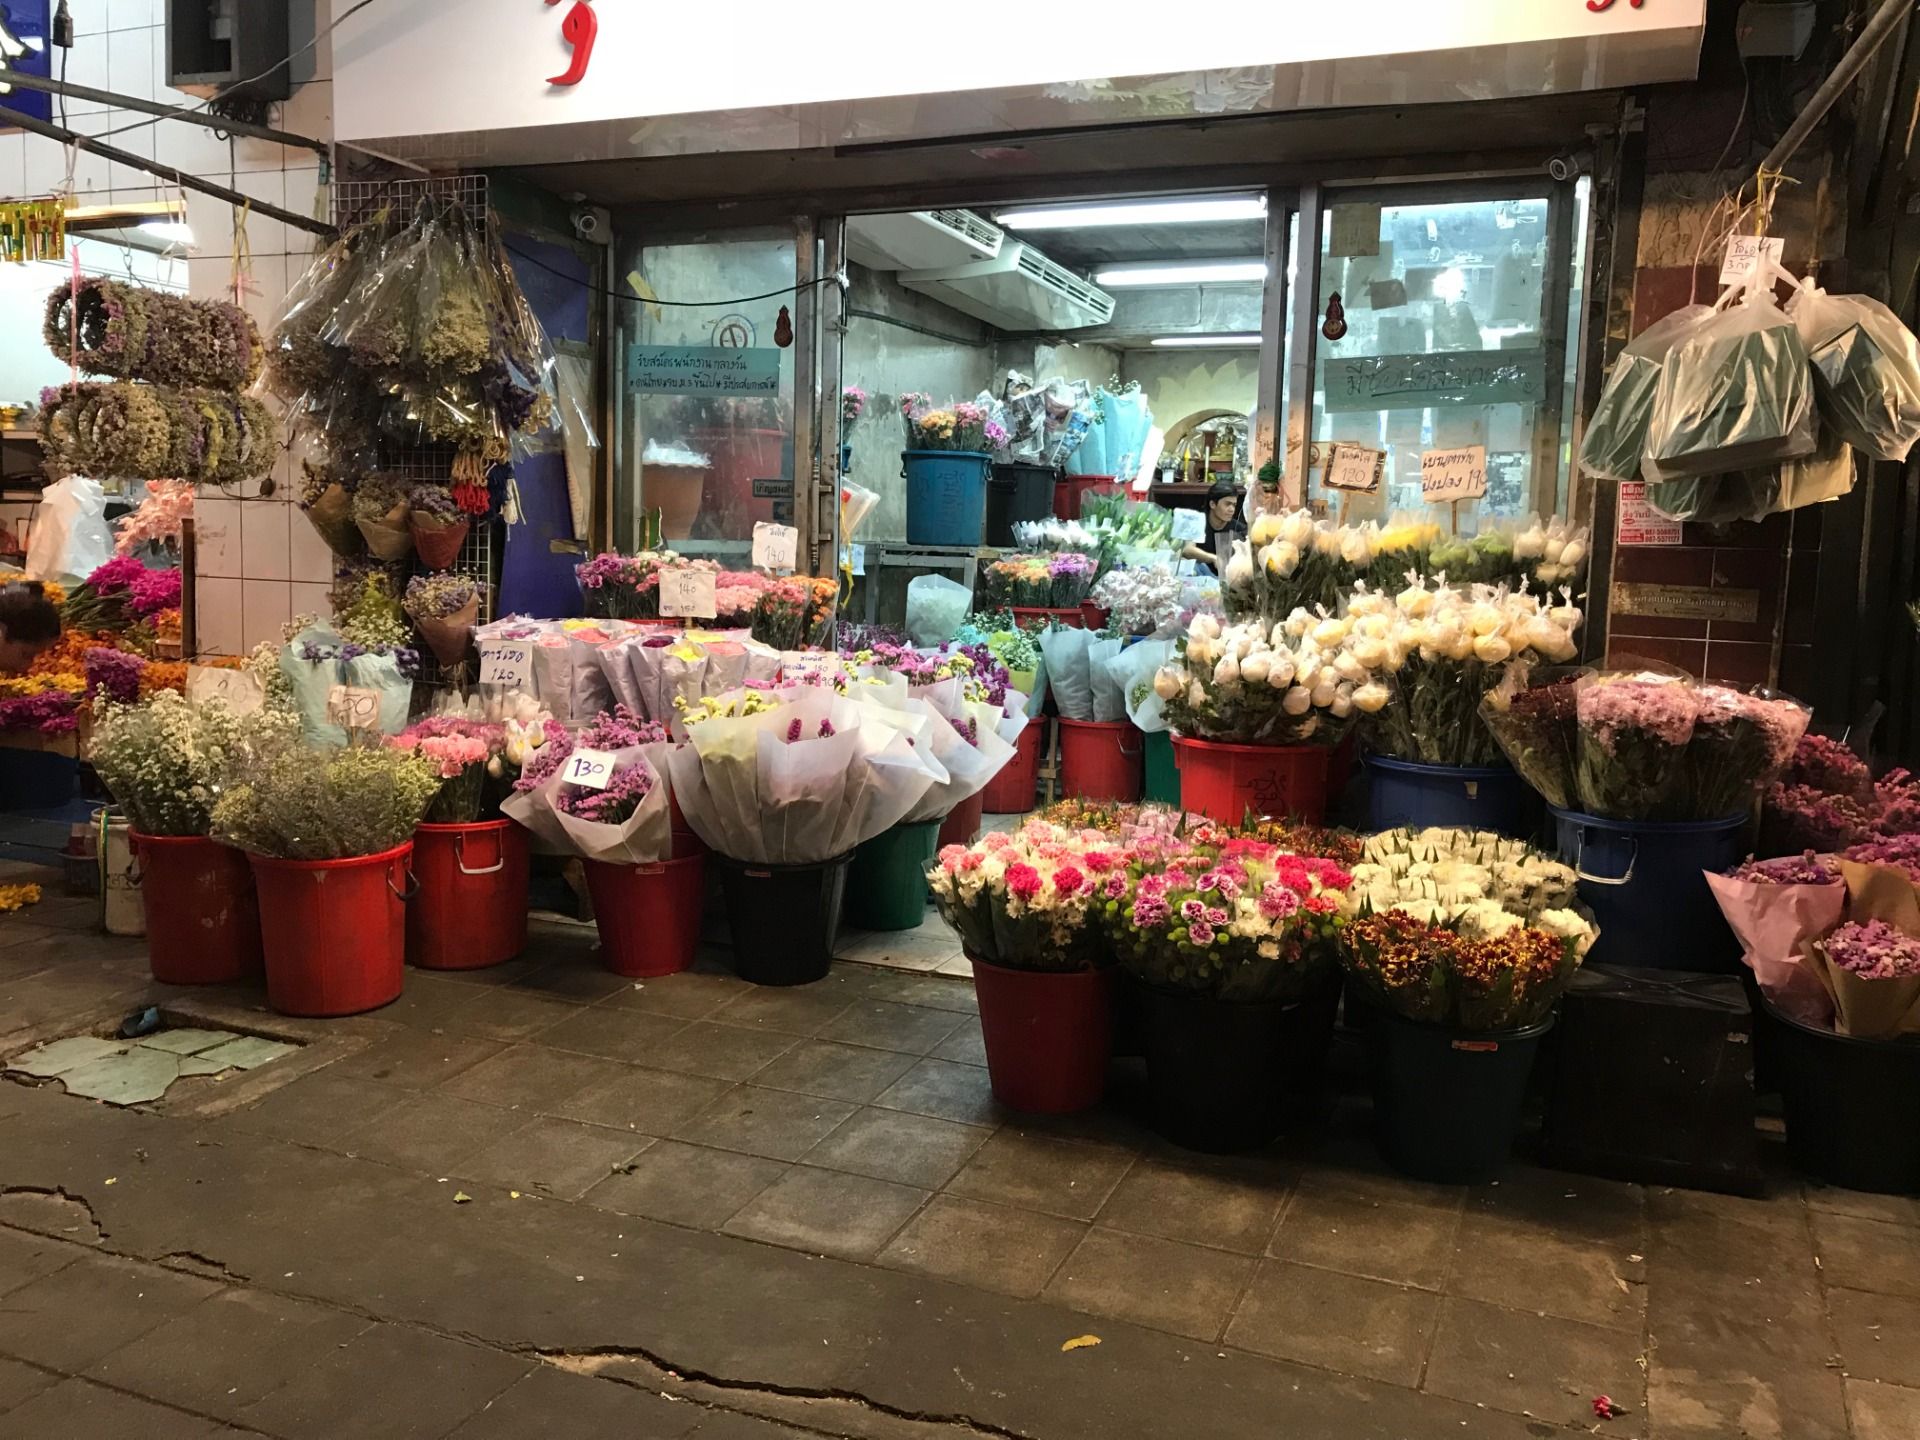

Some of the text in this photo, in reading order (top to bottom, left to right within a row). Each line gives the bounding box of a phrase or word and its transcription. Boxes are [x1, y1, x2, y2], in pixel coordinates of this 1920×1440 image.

[1342, 467, 1366, 482] 120
[678, 583, 697, 595] 140
[491, 667, 515, 681] 120
[573, 757, 605, 778] 130
